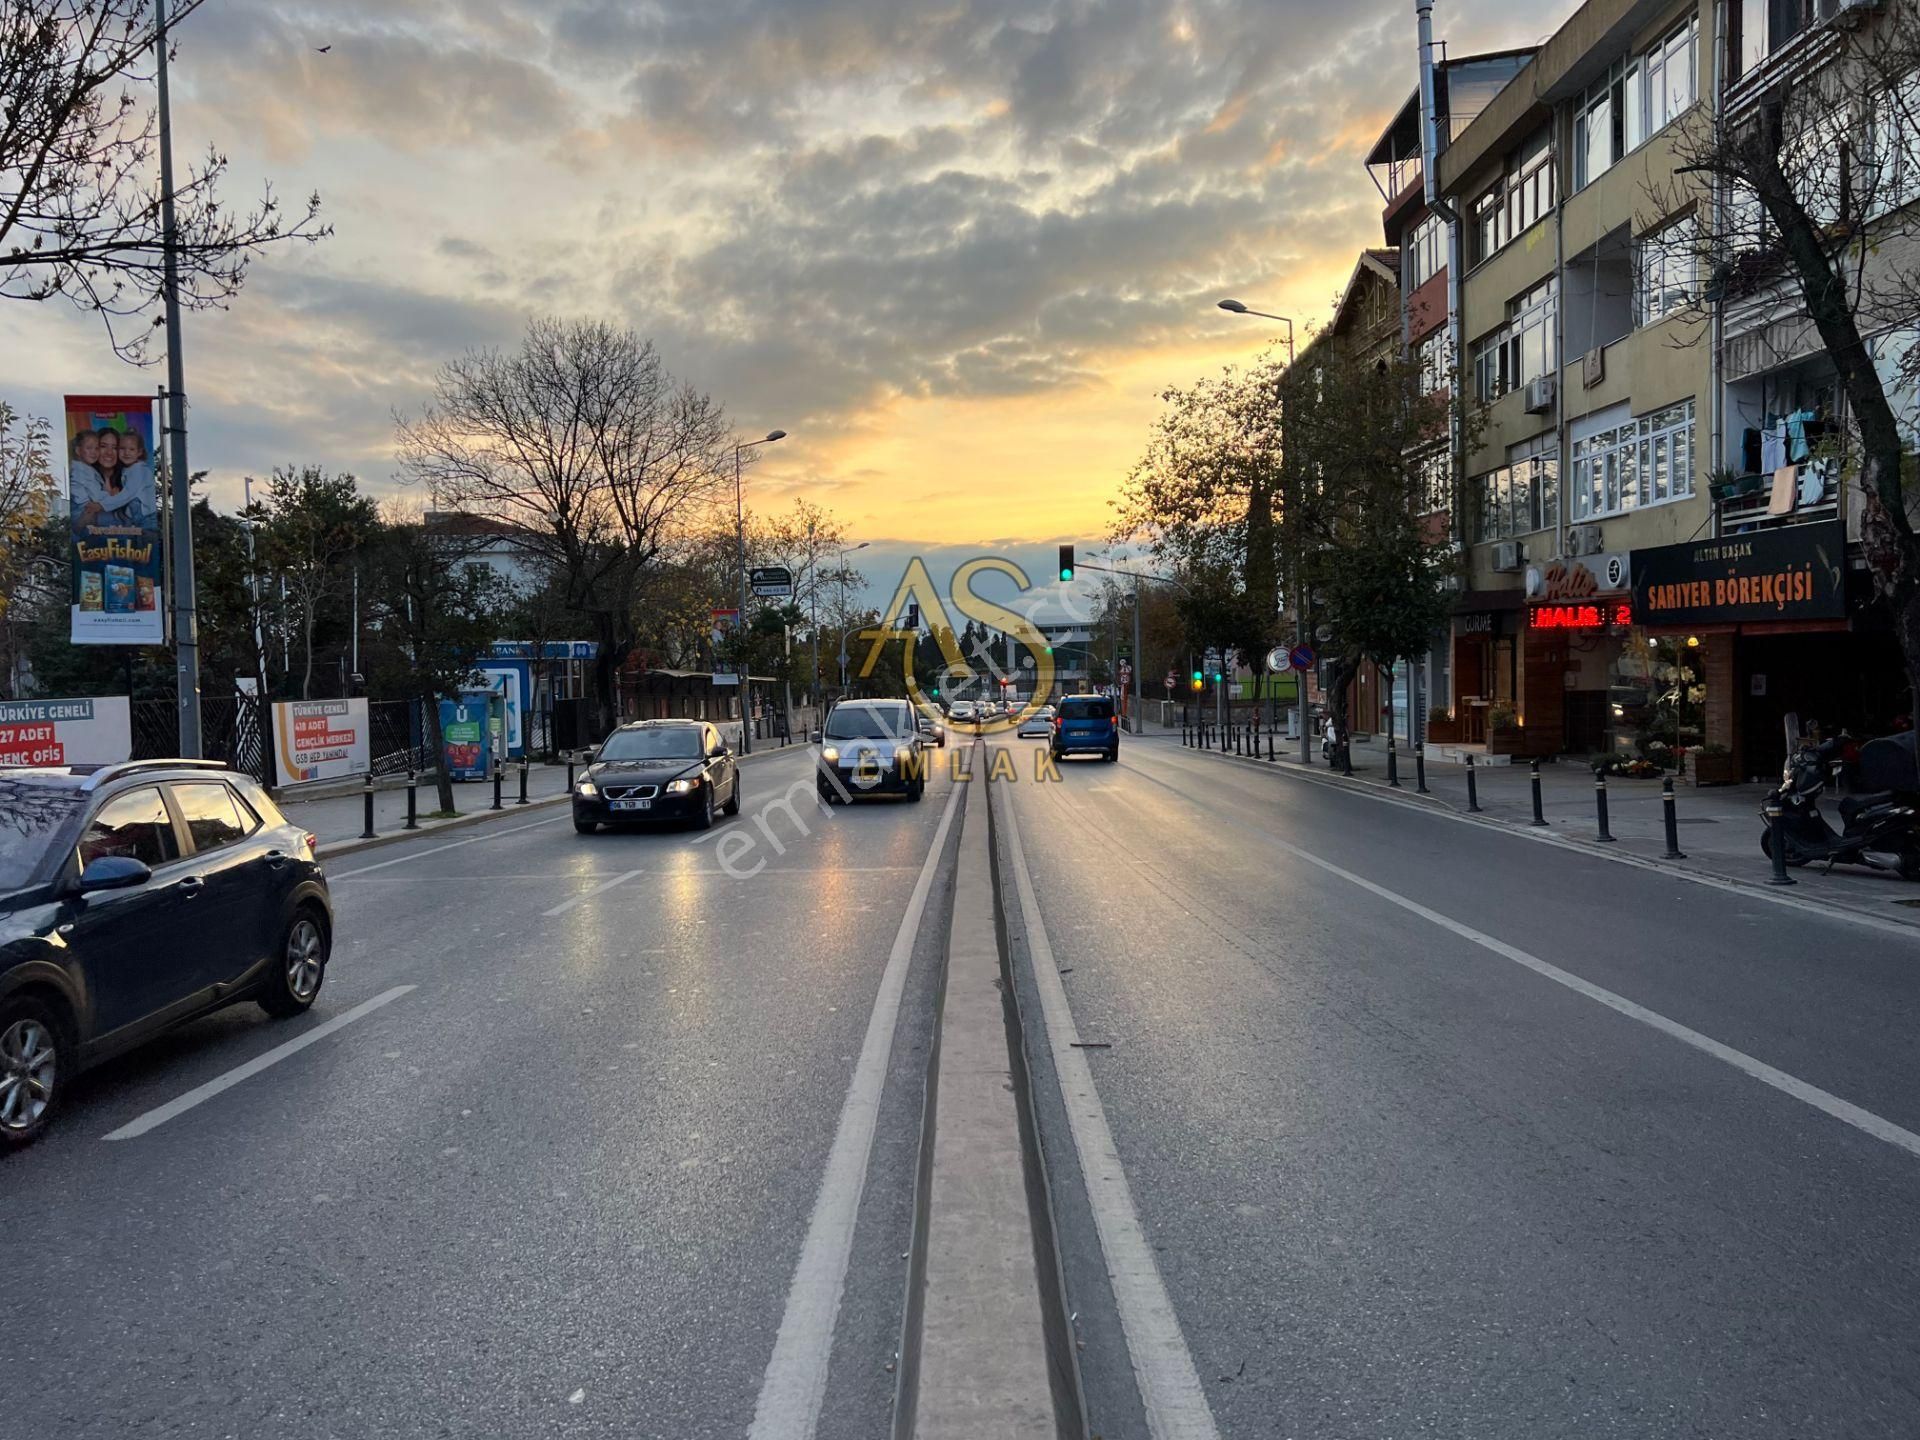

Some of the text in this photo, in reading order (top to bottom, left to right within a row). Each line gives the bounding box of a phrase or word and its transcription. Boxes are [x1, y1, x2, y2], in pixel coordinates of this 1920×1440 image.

[1694, 542, 1752, 562] ALTIN BAŞAK
[1648, 562, 1813, 611] SARIYER BÖREKÇİSİ
[49, 701, 90, 718] GENELİ
[294, 702, 346, 716] TÜRKİYE GENELİ
[307, 720, 326, 730] ADET
[19, 727, 51, 742] ADET
[33, 745, 60, 763] OFİS
